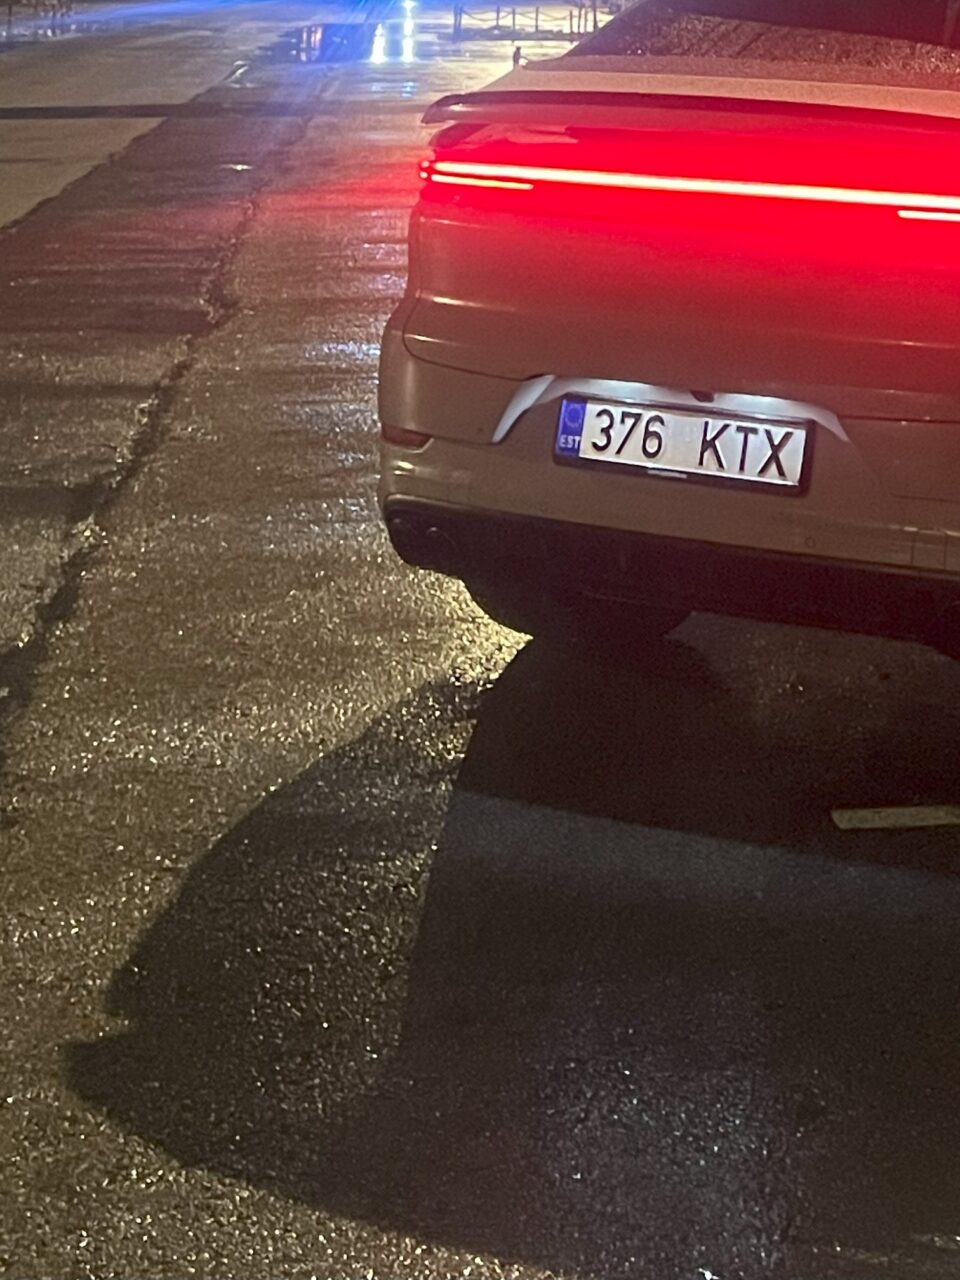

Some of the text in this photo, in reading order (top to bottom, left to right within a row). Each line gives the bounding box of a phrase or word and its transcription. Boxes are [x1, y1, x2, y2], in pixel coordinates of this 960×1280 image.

[559, 434, 581, 449] EST
[591, 408, 794, 478] 376 KTX
